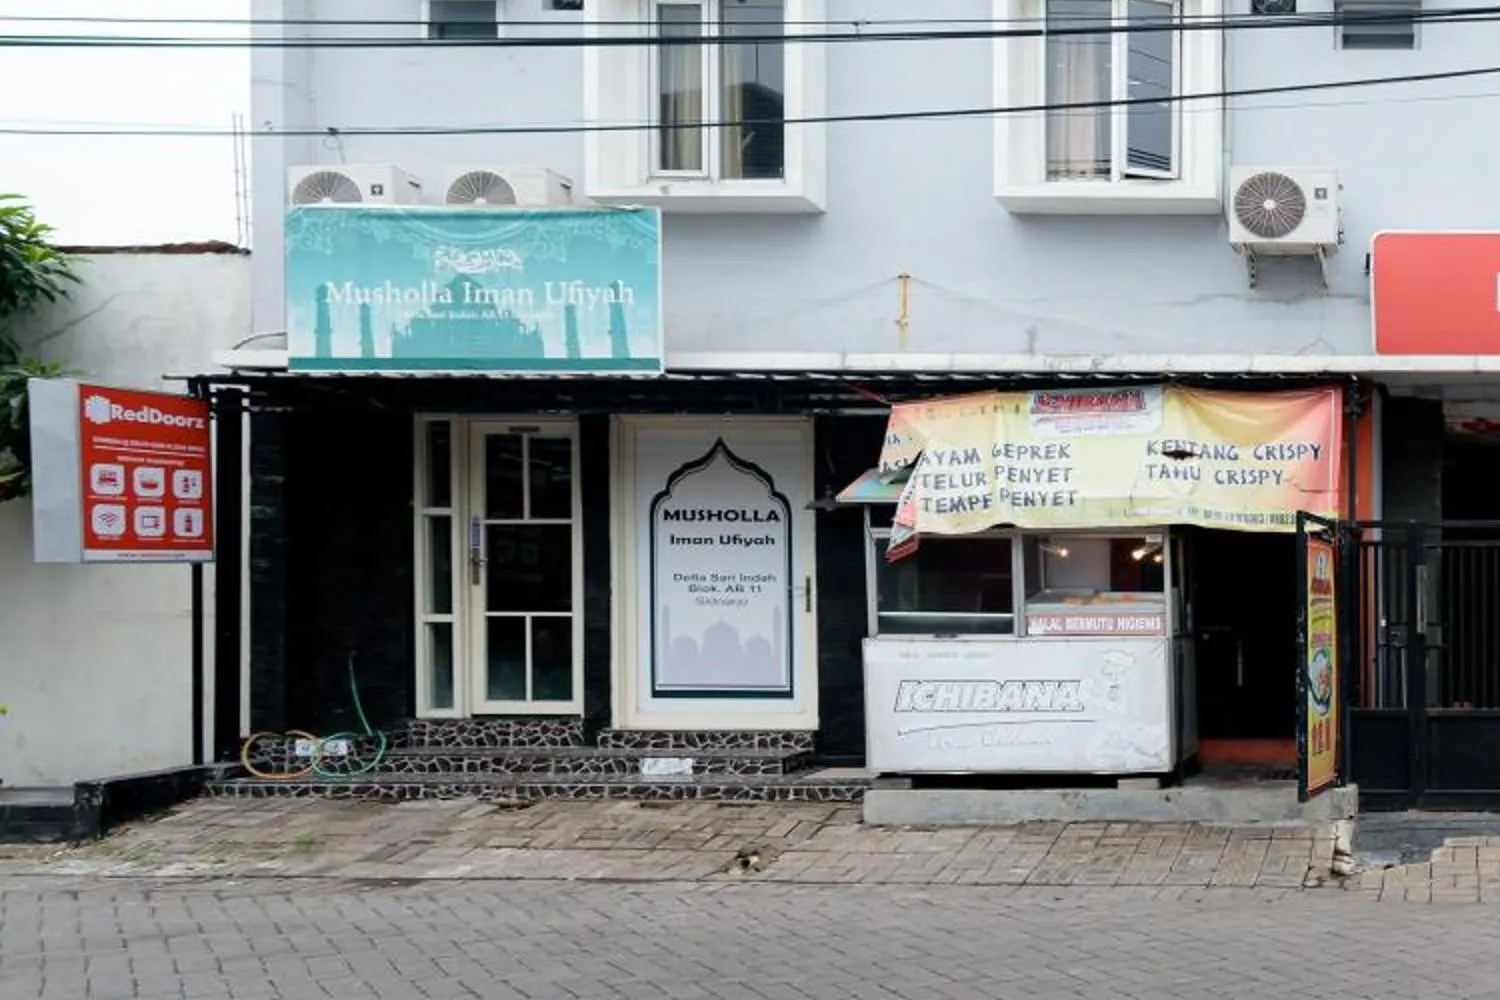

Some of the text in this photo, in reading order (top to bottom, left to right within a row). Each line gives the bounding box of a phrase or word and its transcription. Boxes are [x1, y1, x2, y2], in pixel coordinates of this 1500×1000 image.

[325, 279, 634, 310] Musholla Iman Ufiyah
[111, 403, 205, 429] RedDoorz
[920, 447, 981, 467] AYAM
[992, 443, 1071, 460] GEPREK
[1254, 443, 1321, 461] CRISPY
[920, 465, 1073, 491] TELUR PENYET
[1145, 464, 1284, 485] TAHU CRISPY
[921, 487, 1079, 514] TEMPE PENYET
[663, 509, 781, 522] MUSHOLLA
[670, 534, 775, 547] Iman Ufiyah
[894, 679, 1085, 713] ICHIBANA
